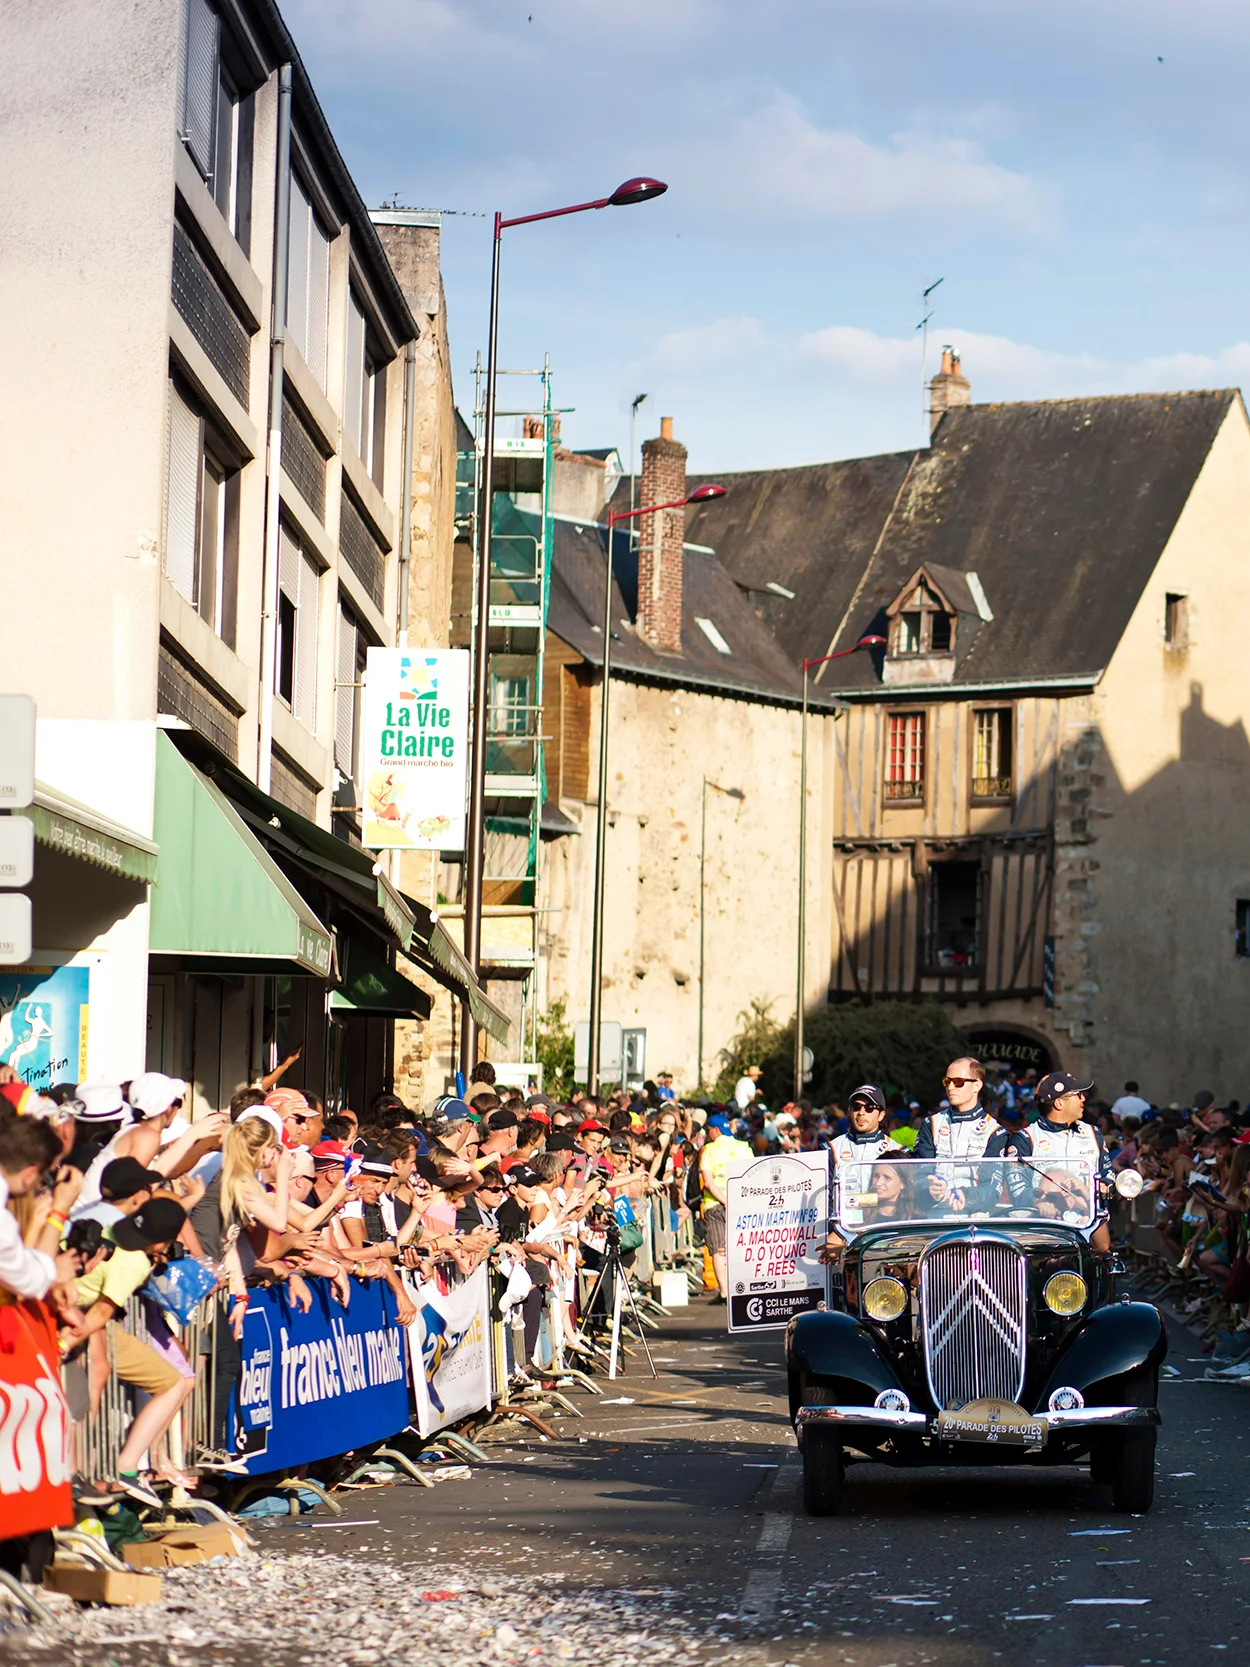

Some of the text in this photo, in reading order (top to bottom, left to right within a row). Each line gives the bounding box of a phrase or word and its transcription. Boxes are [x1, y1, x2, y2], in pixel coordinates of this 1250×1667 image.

[386, 702, 451, 728] La Vie
[380, 729, 455, 758] Claire
[380, 757, 454, 768] Grand marché bio
[22, 1057, 69, 1083] tination
[749, 1185, 774, 1197] PARADE
[774, 1184, 787, 1195] DES
[787, 1179, 813, 1193] PILOTES
[736, 1213, 765, 1230] ASTON
[765, 1209, 799, 1226] MARTIN
[736, 1224, 818, 1247] A. MACDOWALL
[744, 1242, 807, 1263] D. O YOUNG
[754, 1259, 796, 1278] F. REES
[765, 1296, 810, 1308] CCI LE MANS
[765, 1306, 793, 1317] SARTHE
[253, 1348, 271, 1365] france
[280, 1326, 342, 1409] france
[331, 1316, 368, 1394] bleu
[364, 1311, 403, 1387] maine
[240, 1358, 270, 1406] bleu
[956, 1420, 989, 1432] PARADE
[990, 1424, 1007, 1434] DES
[1008, 1422, 1042, 1436] PILOTES
